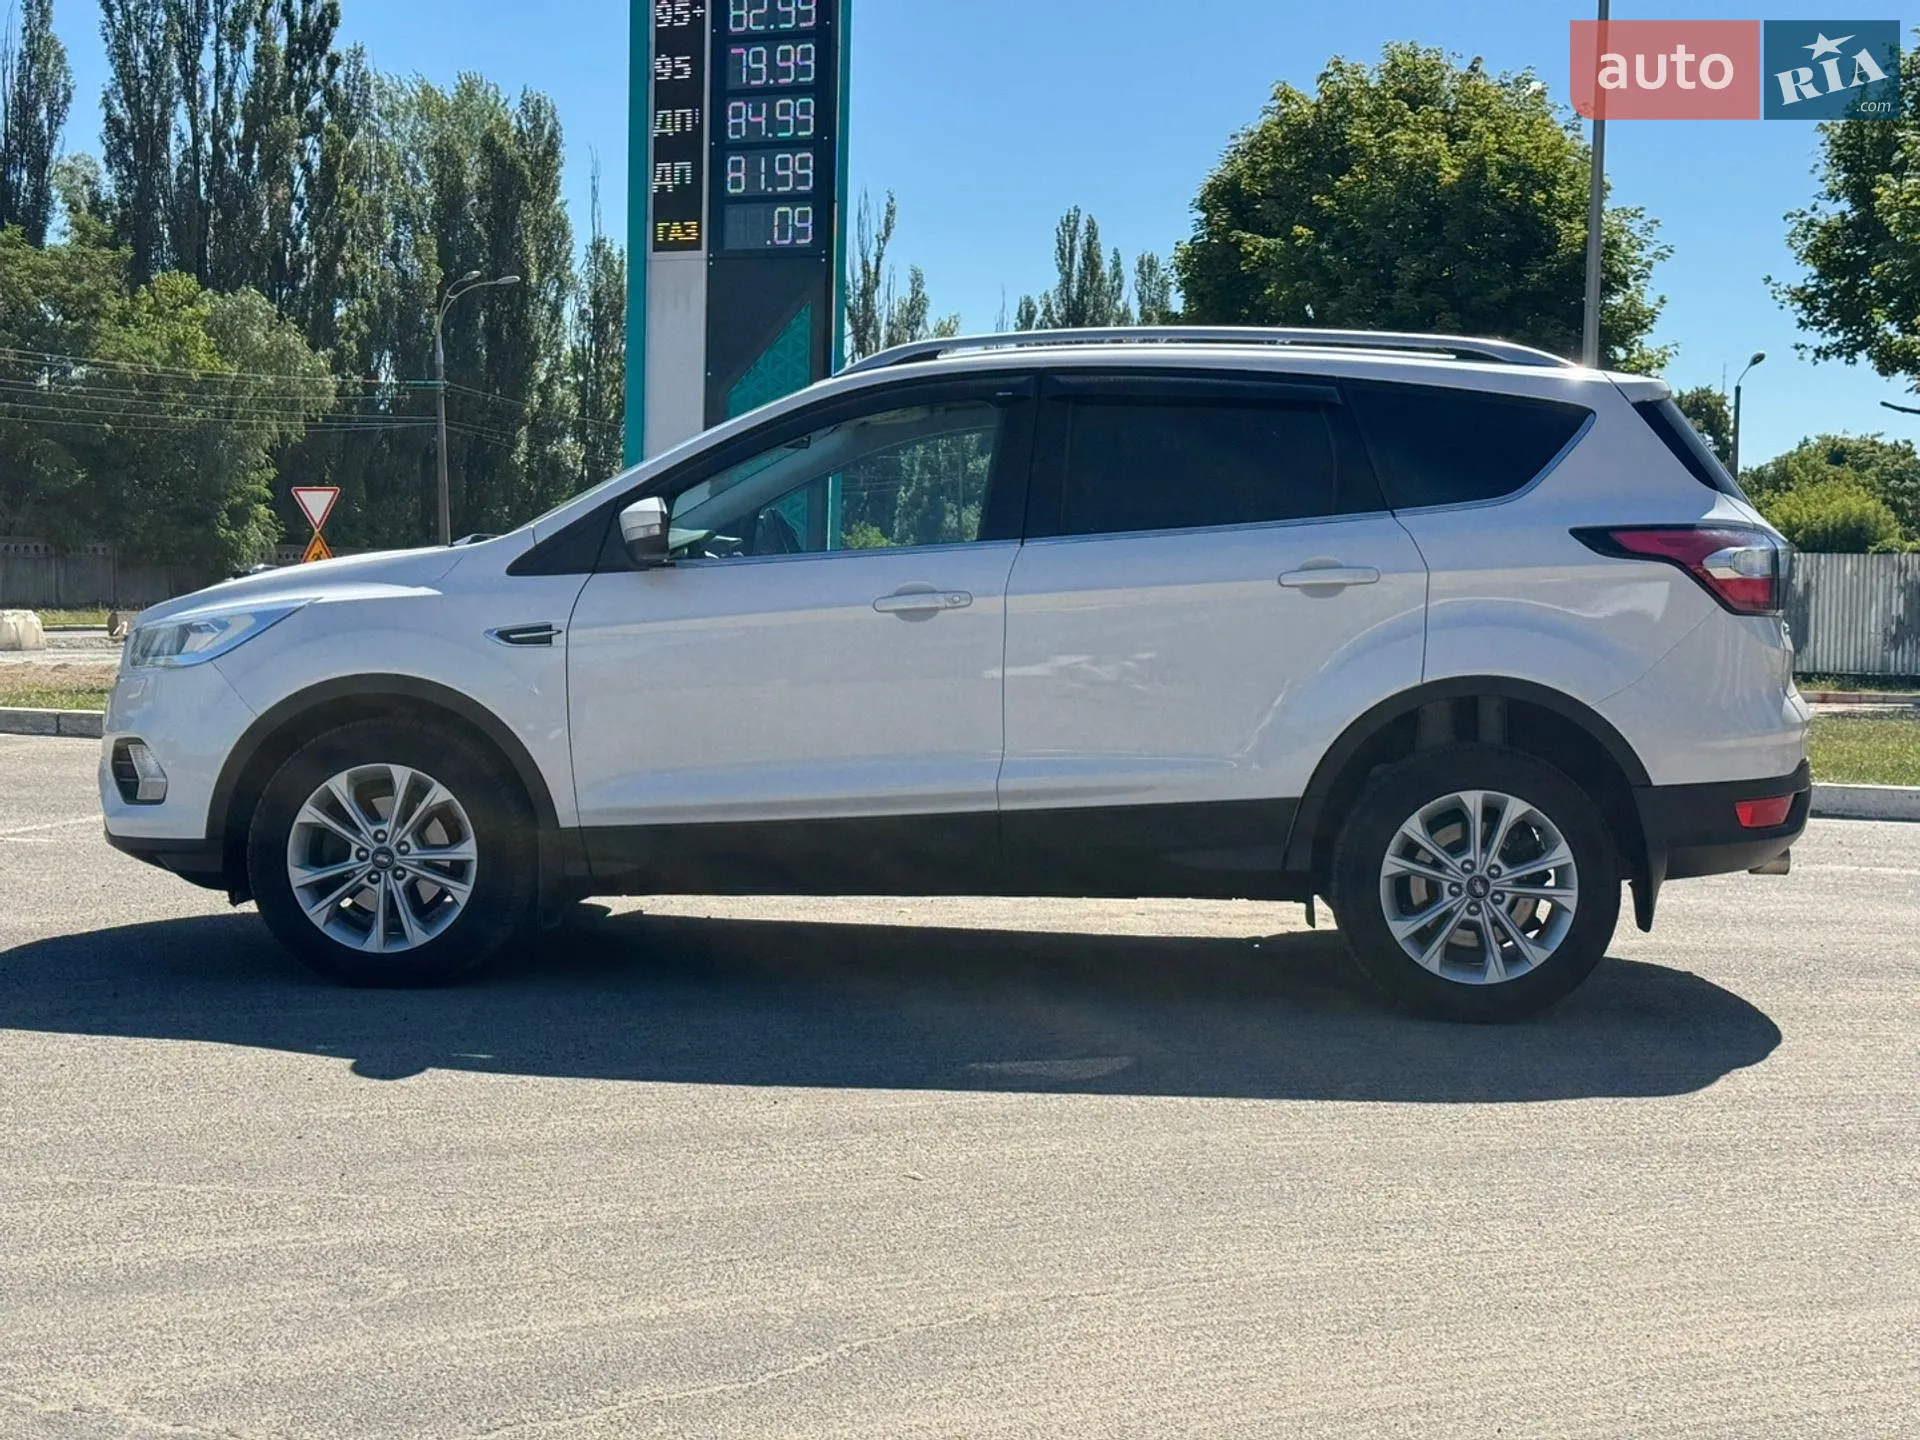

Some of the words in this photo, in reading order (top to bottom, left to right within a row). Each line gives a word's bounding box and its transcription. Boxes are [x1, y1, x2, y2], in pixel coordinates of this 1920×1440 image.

[729, 0, 816, 32] 82.99
[654, 54, 691, 80] 95
[730, 43, 815, 85] 79.99
[728, 98, 815, 139] 84.99
[652, 161, 692, 192] ДП
[727, 152, 813, 193] 81.99
[656, 221, 699, 242] ГАЗ
